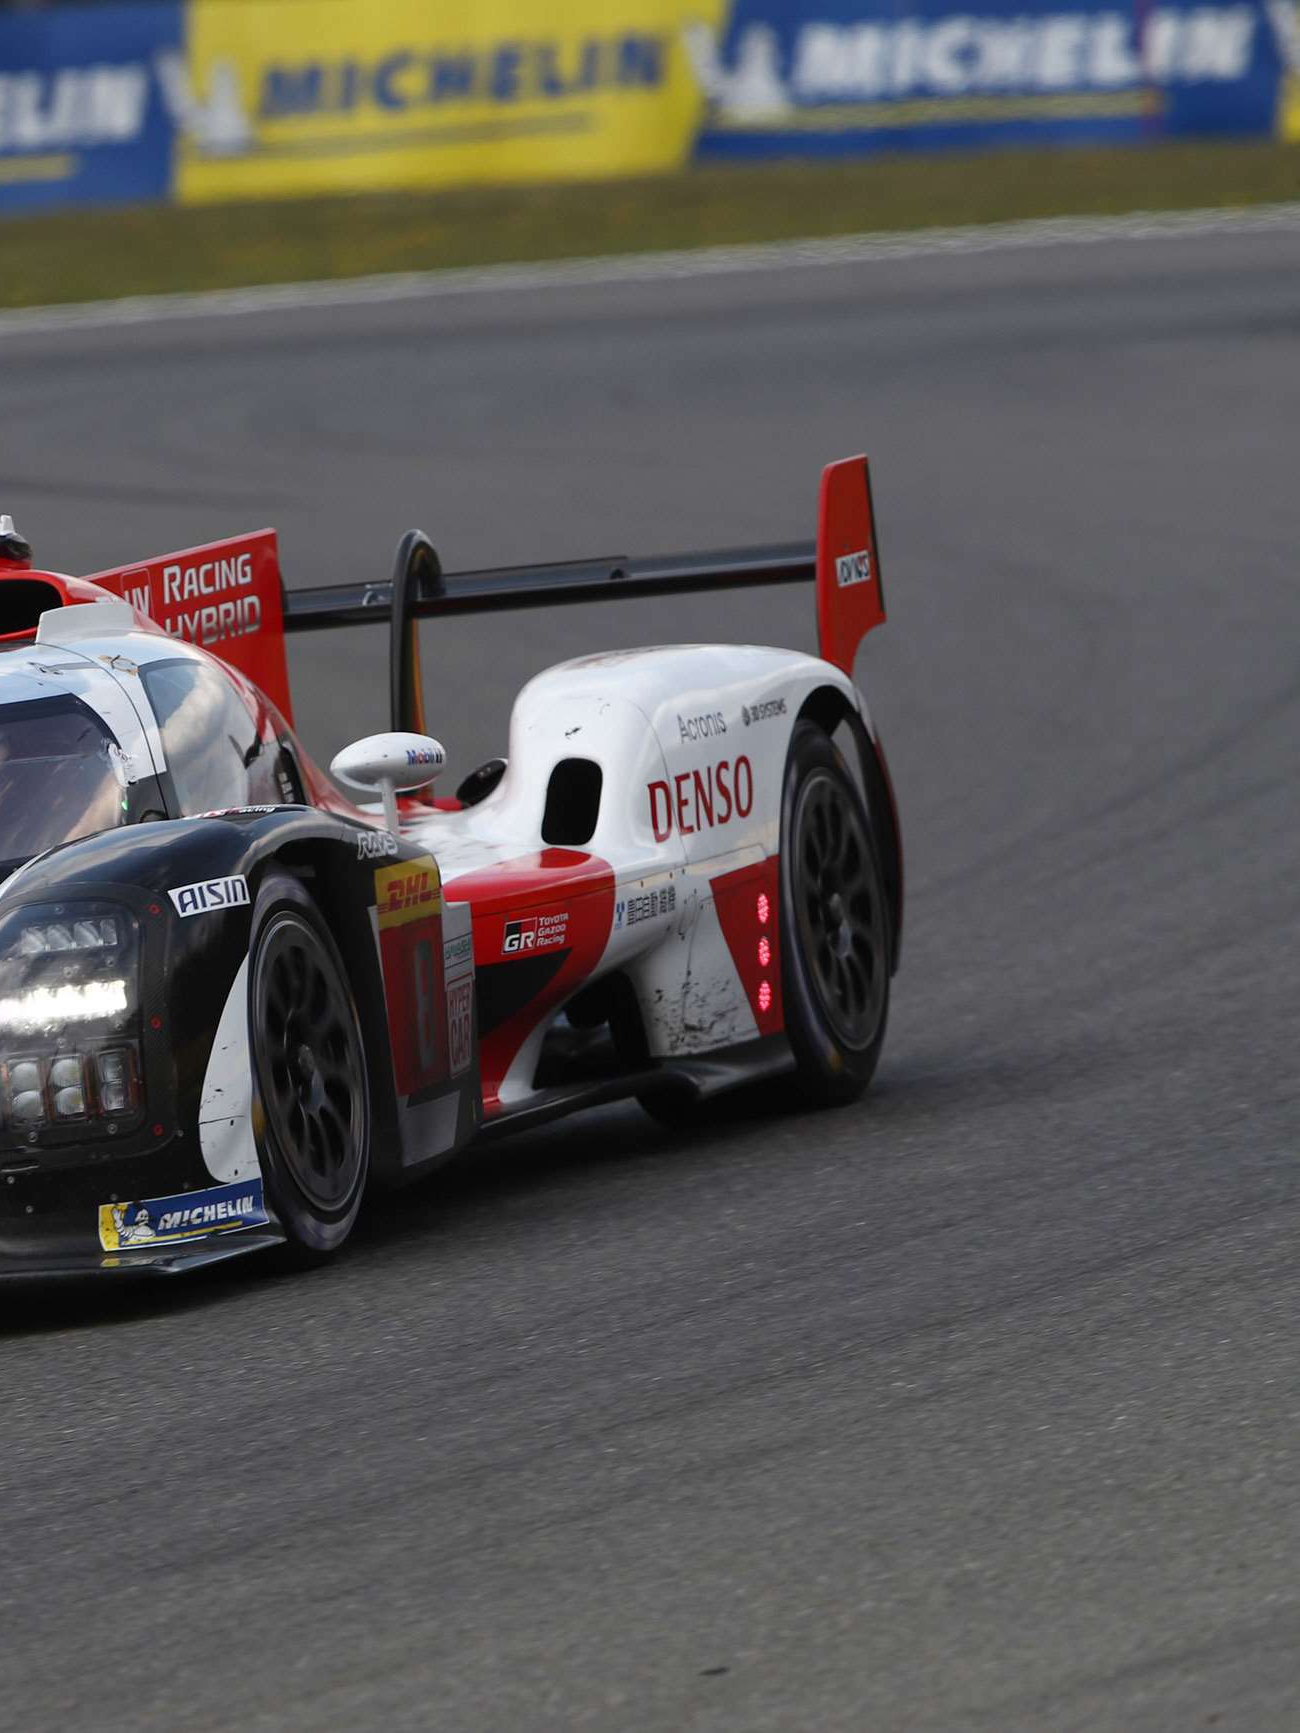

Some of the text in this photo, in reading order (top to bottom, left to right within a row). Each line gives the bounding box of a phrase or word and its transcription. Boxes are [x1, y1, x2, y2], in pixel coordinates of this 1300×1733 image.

[796, 8, 1254, 97] MICHELIN
[259, 33, 661, 119] MICHELIN
[162, 553, 253, 605] RACING
[164, 595, 262, 645] HYBRID
[677, 712, 727, 744] Acronis
[647, 755, 754, 844] DENSO
[177, 878, 247, 913] AISIN
[387, 872, 431, 911] DHL
[537, 923, 567, 937] GAZOO
[538, 913, 569, 927] TOYOTA
[503, 932, 535, 952] GR
[536, 934, 565, 948] Racing
[158, 1195, 255, 1231] MICHELIN
